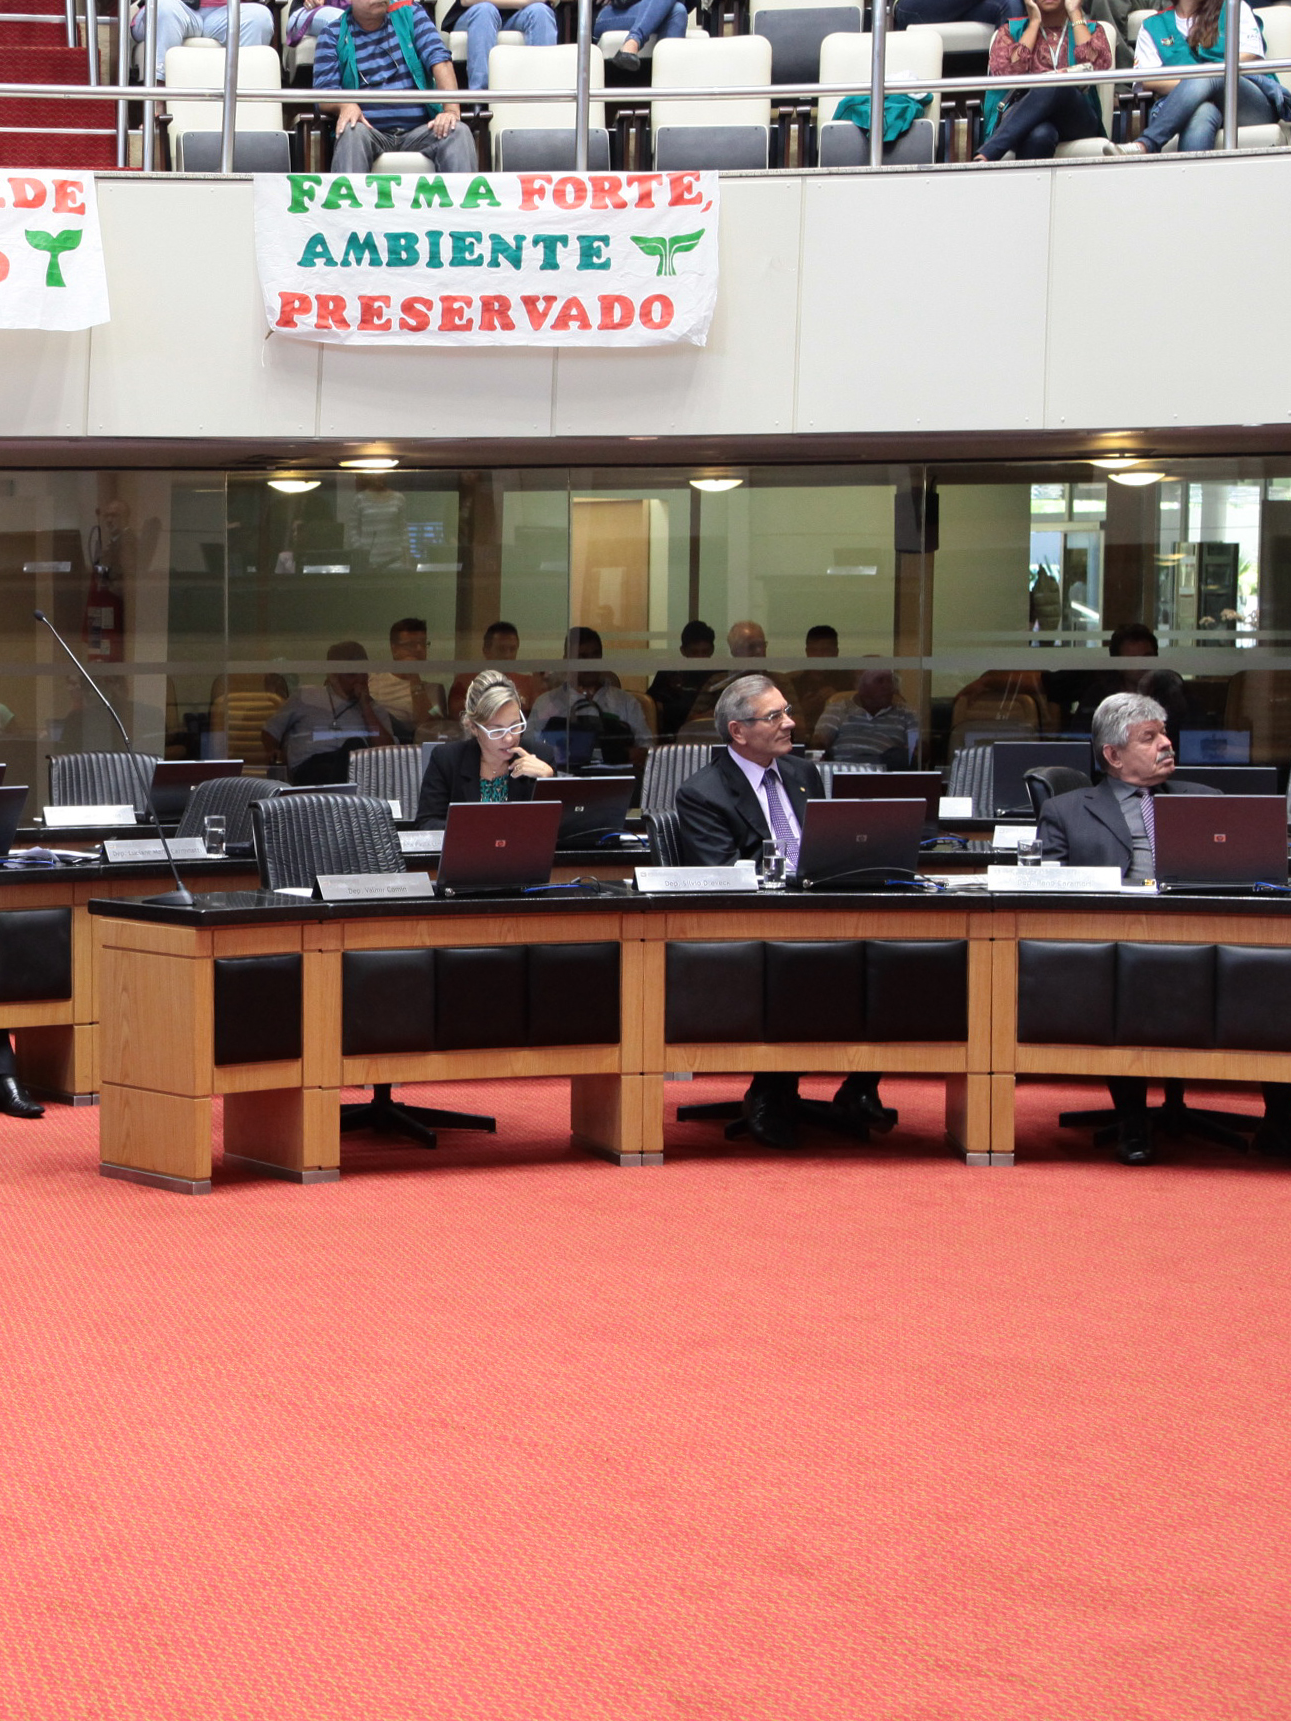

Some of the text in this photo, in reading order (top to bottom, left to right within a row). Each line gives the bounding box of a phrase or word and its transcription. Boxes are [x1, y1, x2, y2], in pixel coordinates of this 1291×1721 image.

[286, 170, 714, 214] FATMA FORTE,
[296, 230, 611, 271] AMBIENTE
[274, 291, 675, 332] PRESERVADO
